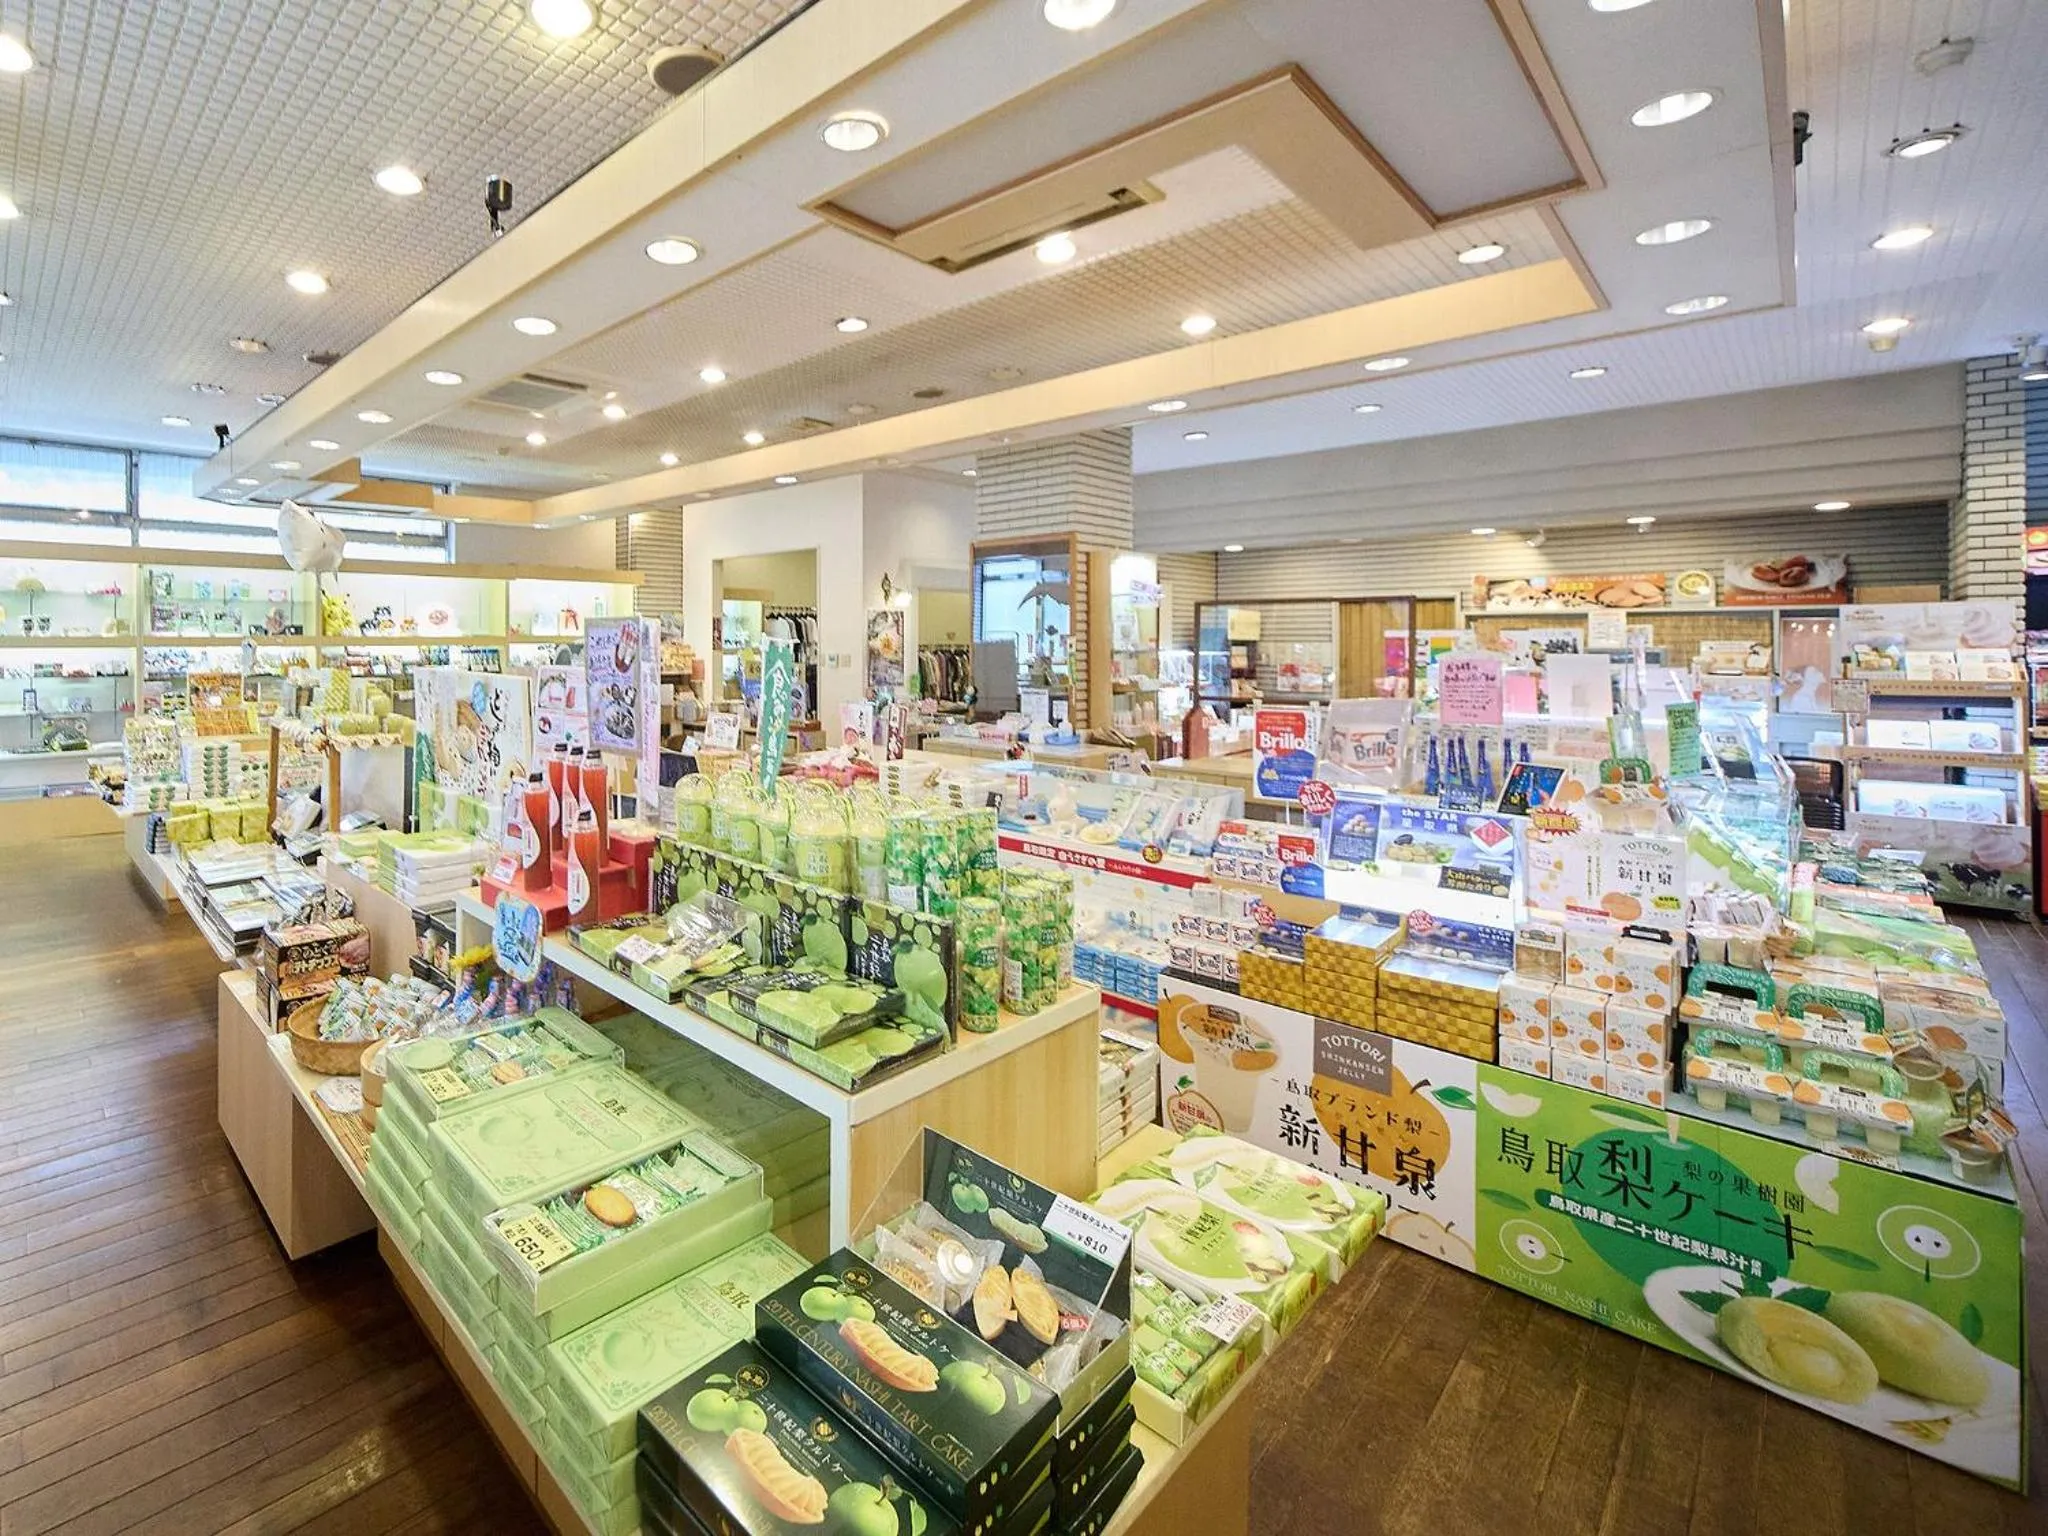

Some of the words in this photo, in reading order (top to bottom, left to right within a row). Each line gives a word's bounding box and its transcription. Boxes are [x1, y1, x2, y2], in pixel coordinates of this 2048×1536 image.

[1259, 731, 1308, 750] Brillo
[1353, 741, 1395, 761] Brillo
[1401, 807, 1421, 818] the
[1424, 810, 1458, 822] STAR
[1281, 848, 1315, 866] Brillo
[1321, 1035, 1386, 1063] TOTTORI
[1321, 1050, 1384, 1076] SHINKANSEN
[1337, 1066, 1366, 1080] JELLY
[1279, 1103, 1437, 1201] 新甘泉
[1497, 1126, 1815, 1262] 鳥取梨ケーキ
[514, 1236, 545, 1261] 650
[1496, 1264, 1559, 1297] TOTTORI
[1564, 1289, 1609, 1316] NASHI
[1614, 1309, 1660, 1334] CAKE
[764, 1299, 800, 1327] 20TH
[796, 1324, 852, 1370] CENTURY
[854, 1368, 893, 1404] NASHI
[890, 1399, 933, 1435] TART
[930, 1434, 974, 1471] CAKE
